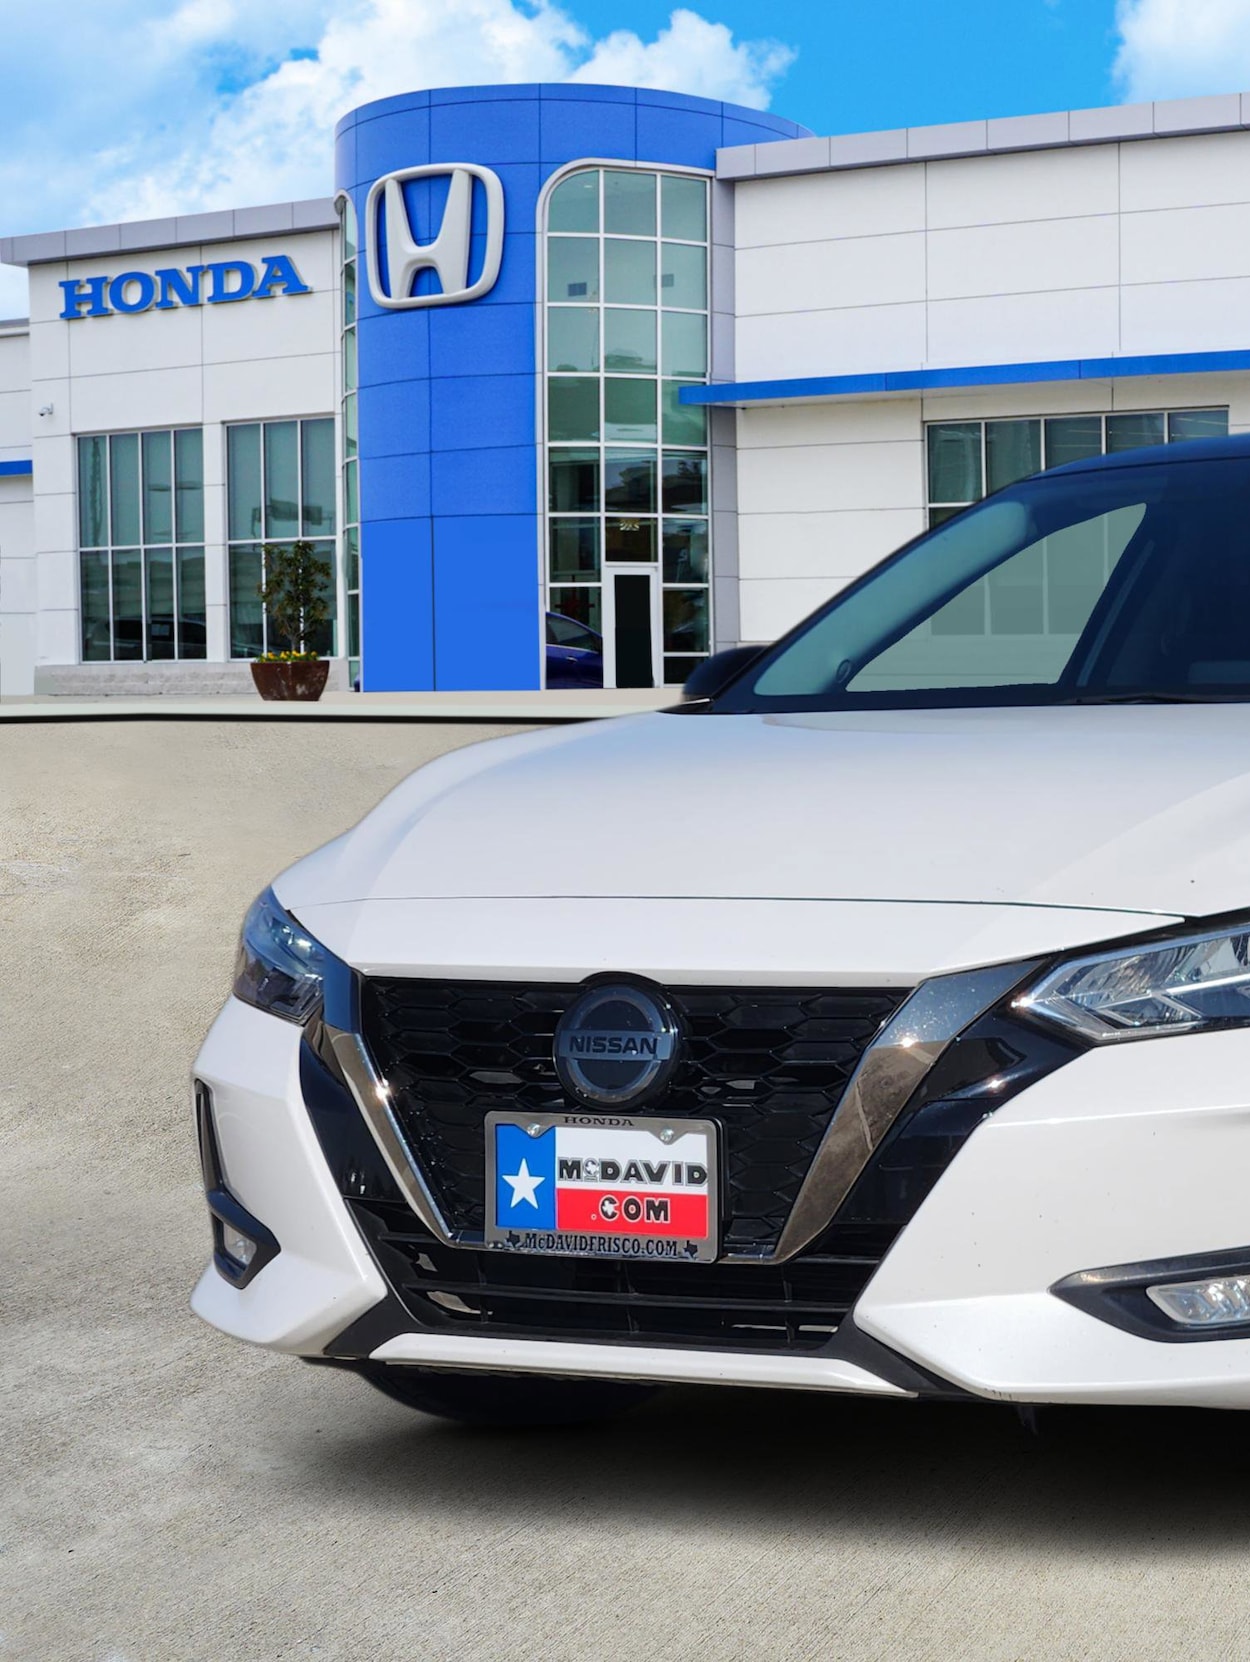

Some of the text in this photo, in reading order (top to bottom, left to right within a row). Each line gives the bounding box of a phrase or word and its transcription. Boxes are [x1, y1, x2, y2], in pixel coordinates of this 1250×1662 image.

[59, 254, 311, 319] HONDA
[569, 1036, 658, 1055] NISSAN
[564, 1116, 634, 1126] HONDA
